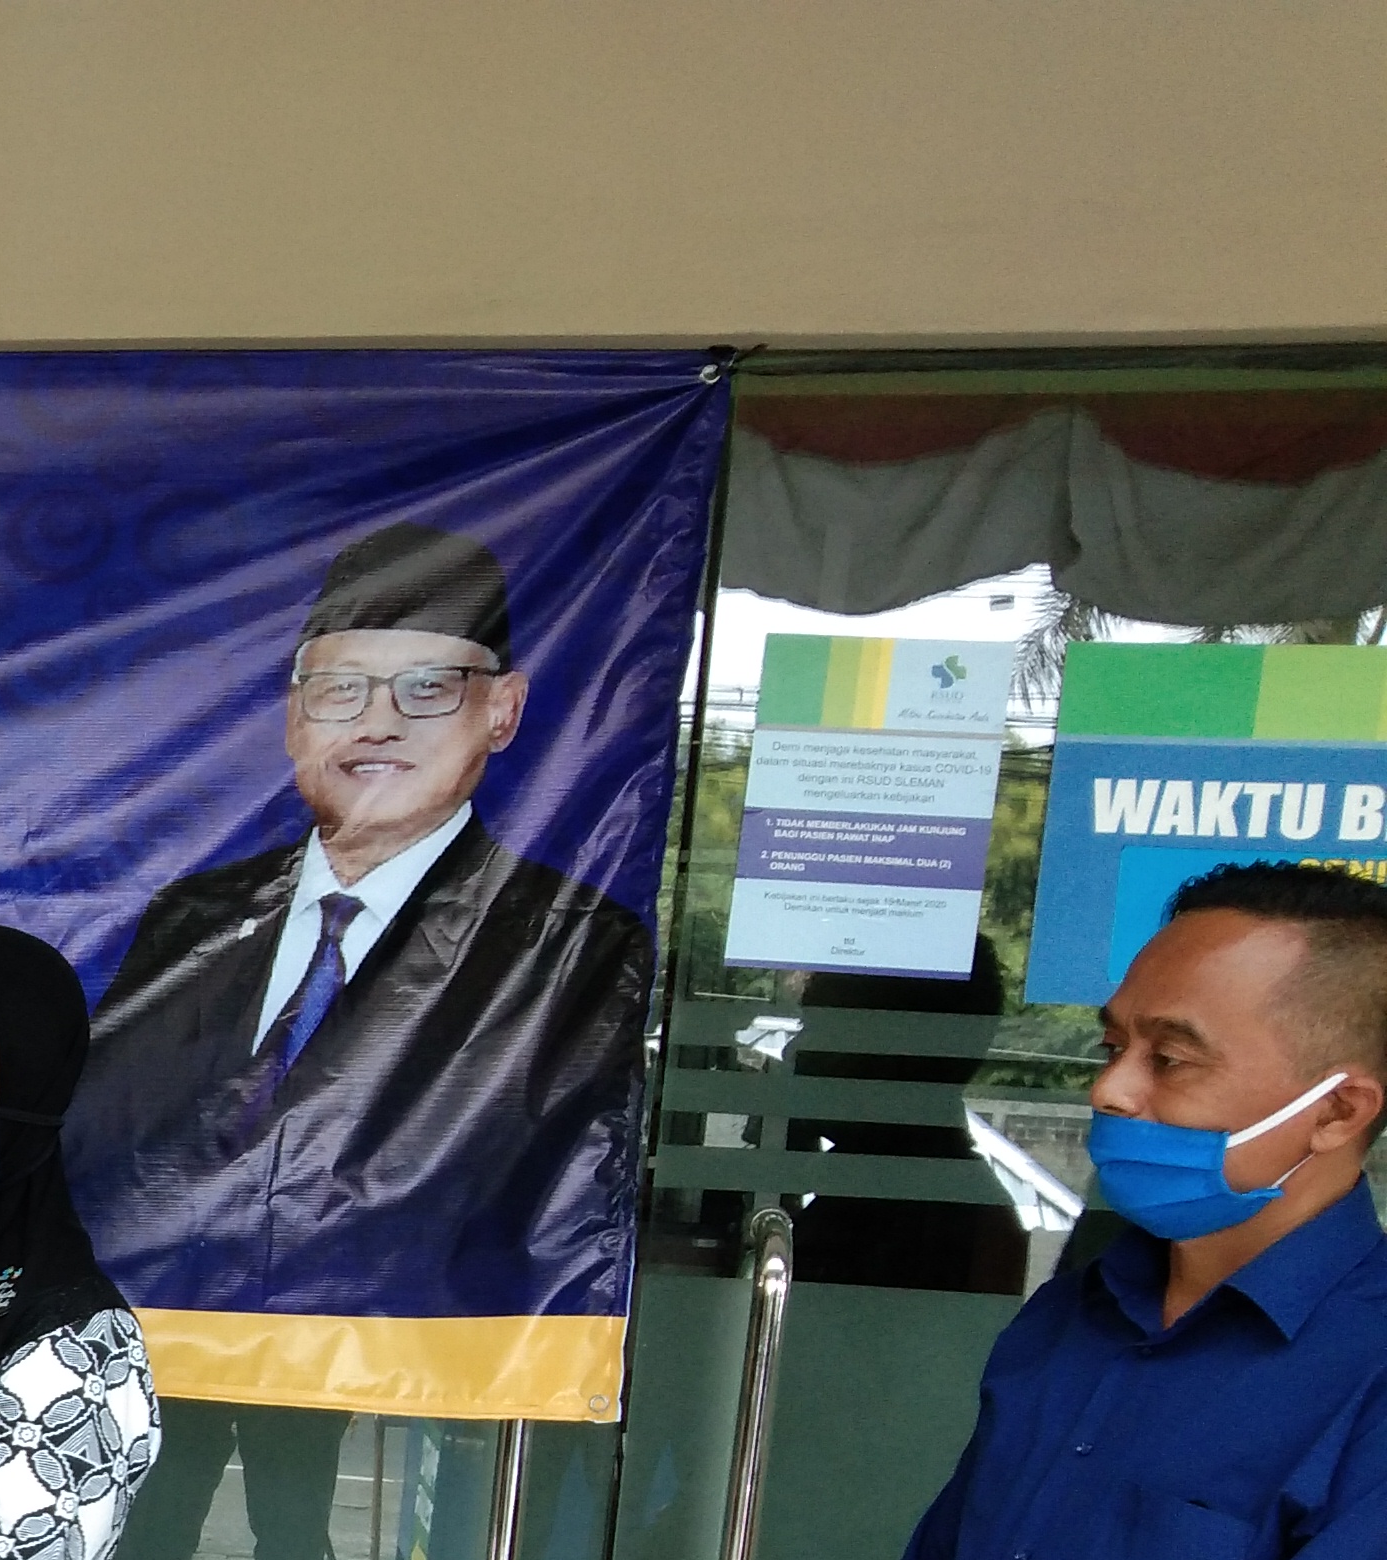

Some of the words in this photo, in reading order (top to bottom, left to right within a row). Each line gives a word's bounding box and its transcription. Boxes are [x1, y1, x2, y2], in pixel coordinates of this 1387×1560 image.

[772, 741, 801, 751] Demi
[803, 744, 850, 756] menjaga
[853, 744, 910, 756] kesehatan
[756, 757, 789, 766] dalam
[792, 758, 826, 768] situasi
[829, 760, 897, 773] merebaknya
[899, 762, 931, 773] kasus
[935, 763, 991, 775] COVID-19
[798, 773, 838, 785] dengan
[841, 775, 854, 784] ini
[856, 775, 891, 786] RSUD
[895, 777, 945, 788] SLEMAN
[804, 789, 880, 801] mengeluarkan
[883, 791, 935, 804] kebijakan
[1093, 777, 1324, 841] WAKTU
[776, 818, 804, 828] TIDAK
[806, 820, 895, 833] MEMBERLAKUKAN
[897, 824, 917, 833] JAM
[919, 825, 967, 836] KUNJUNG
[774, 830, 799, 839] BAGI
[800, 831, 835, 840] PASIEN
[836, 832, 870, 841] RAWAT
[872, 834, 895, 843] INAP
[770, 862, 805, 871] ORANG
[771, 851, 826, 862] PENUNGGU
[827, 854, 862, 864] PASIEN
[864, 855, 915, 867] MAKSIMAL
[917, 858, 938, 867] DUA
